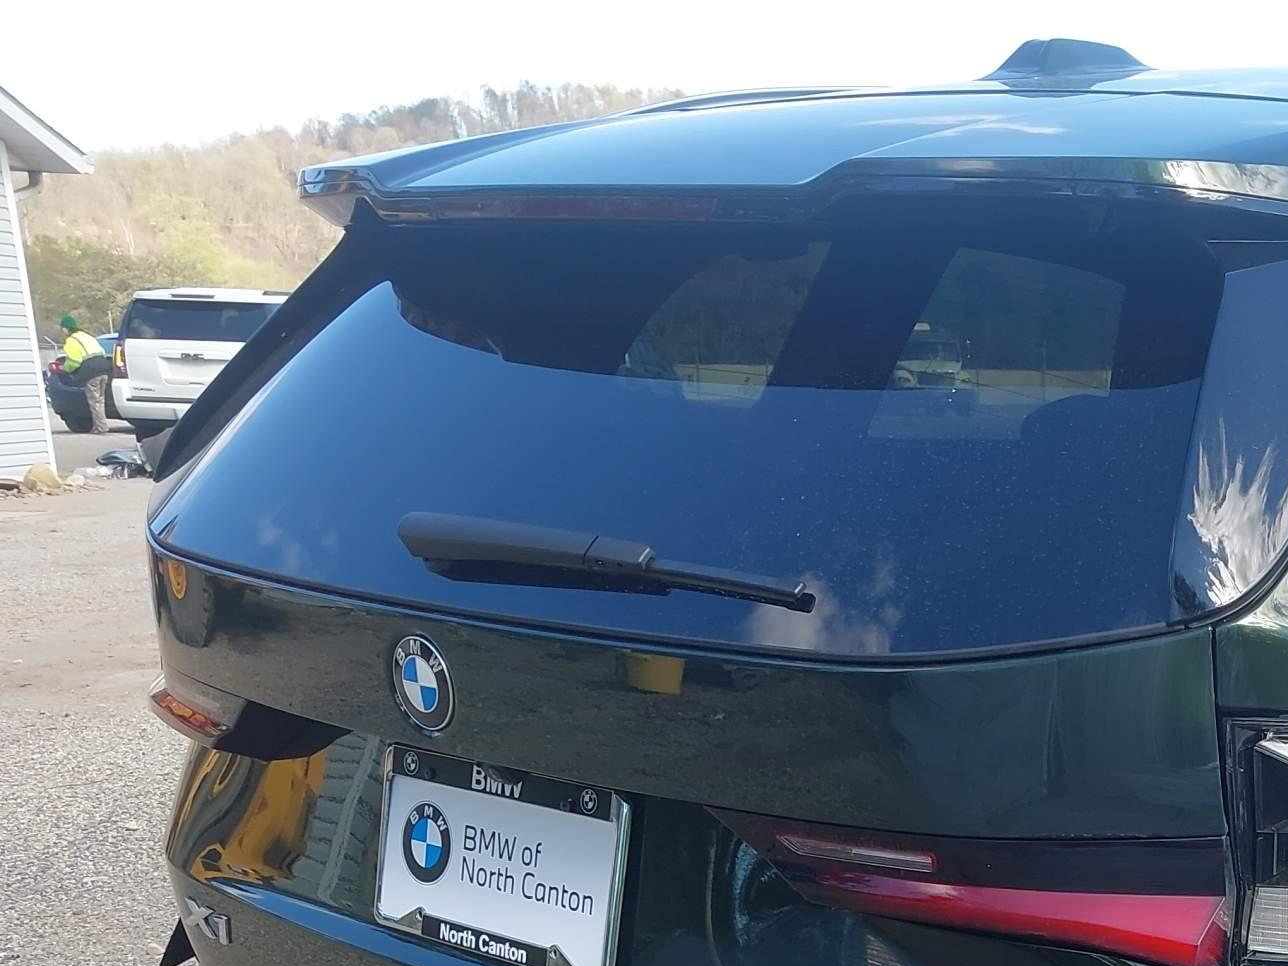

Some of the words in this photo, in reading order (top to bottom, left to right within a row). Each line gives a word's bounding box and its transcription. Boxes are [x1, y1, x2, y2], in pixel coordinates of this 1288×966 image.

[396, 639, 443, 673] BMW
[409, 805, 447, 832] BMW
[463, 824, 517, 862] BMW
[522, 841, 543, 868] of
[460, 857, 516, 897] North
[521, 872, 594, 916] Canton
[439, 922, 476, 950] North
[478, 937, 527, 964] Canton
